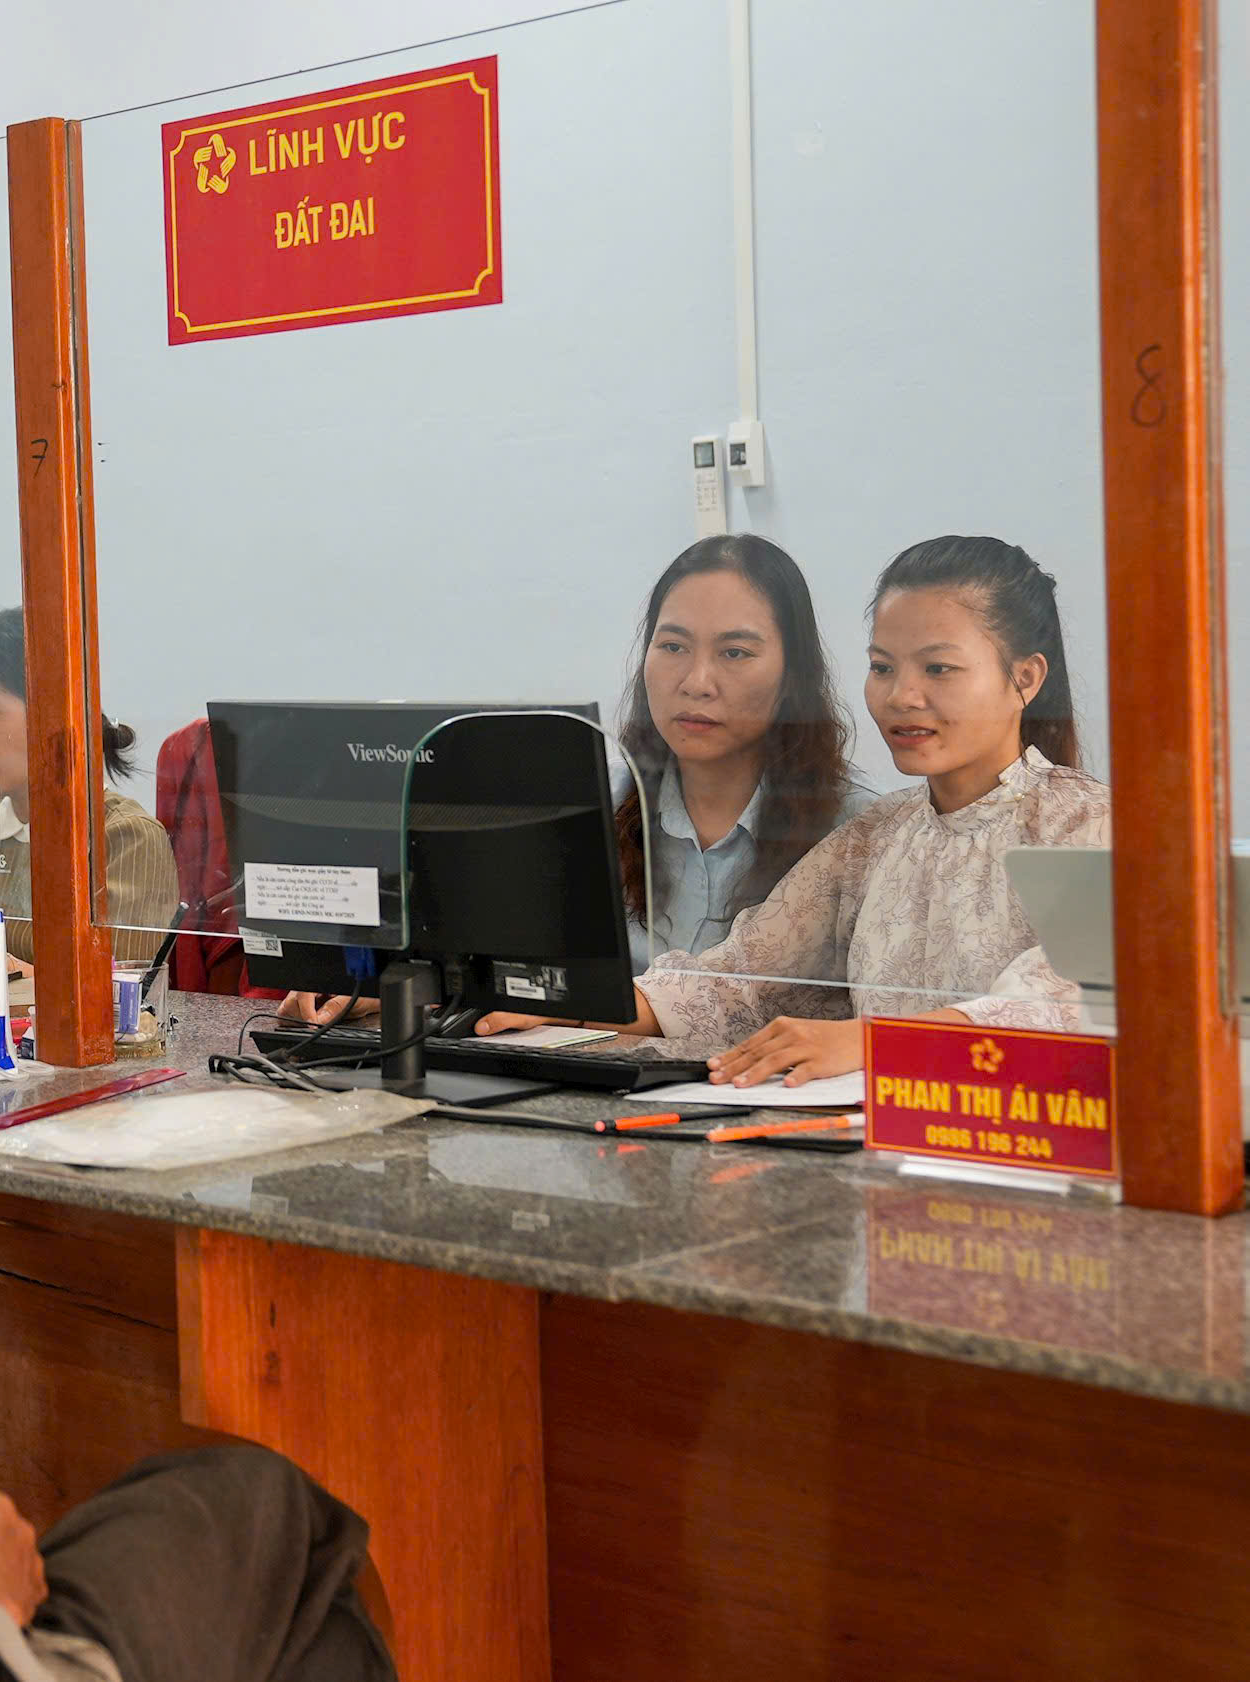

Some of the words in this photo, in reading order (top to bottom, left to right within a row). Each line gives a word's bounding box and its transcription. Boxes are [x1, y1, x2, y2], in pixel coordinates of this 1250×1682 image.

[249, 128, 325, 176] LĨNH
[333, 111, 406, 164] VỰC
[274, 196, 324, 249] ĐẤT
[329, 197, 375, 241] ĐAI
[31, 438, 48, 480] 7
[876, 1076, 951, 1113] PHAN
[957, 1084, 1002, 1126] THỊ
[1008, 1083, 1039, 1123] ÁI
[1046, 1089, 1108, 1131] VÂN
[1015, 1134, 1053, 1160] 244
